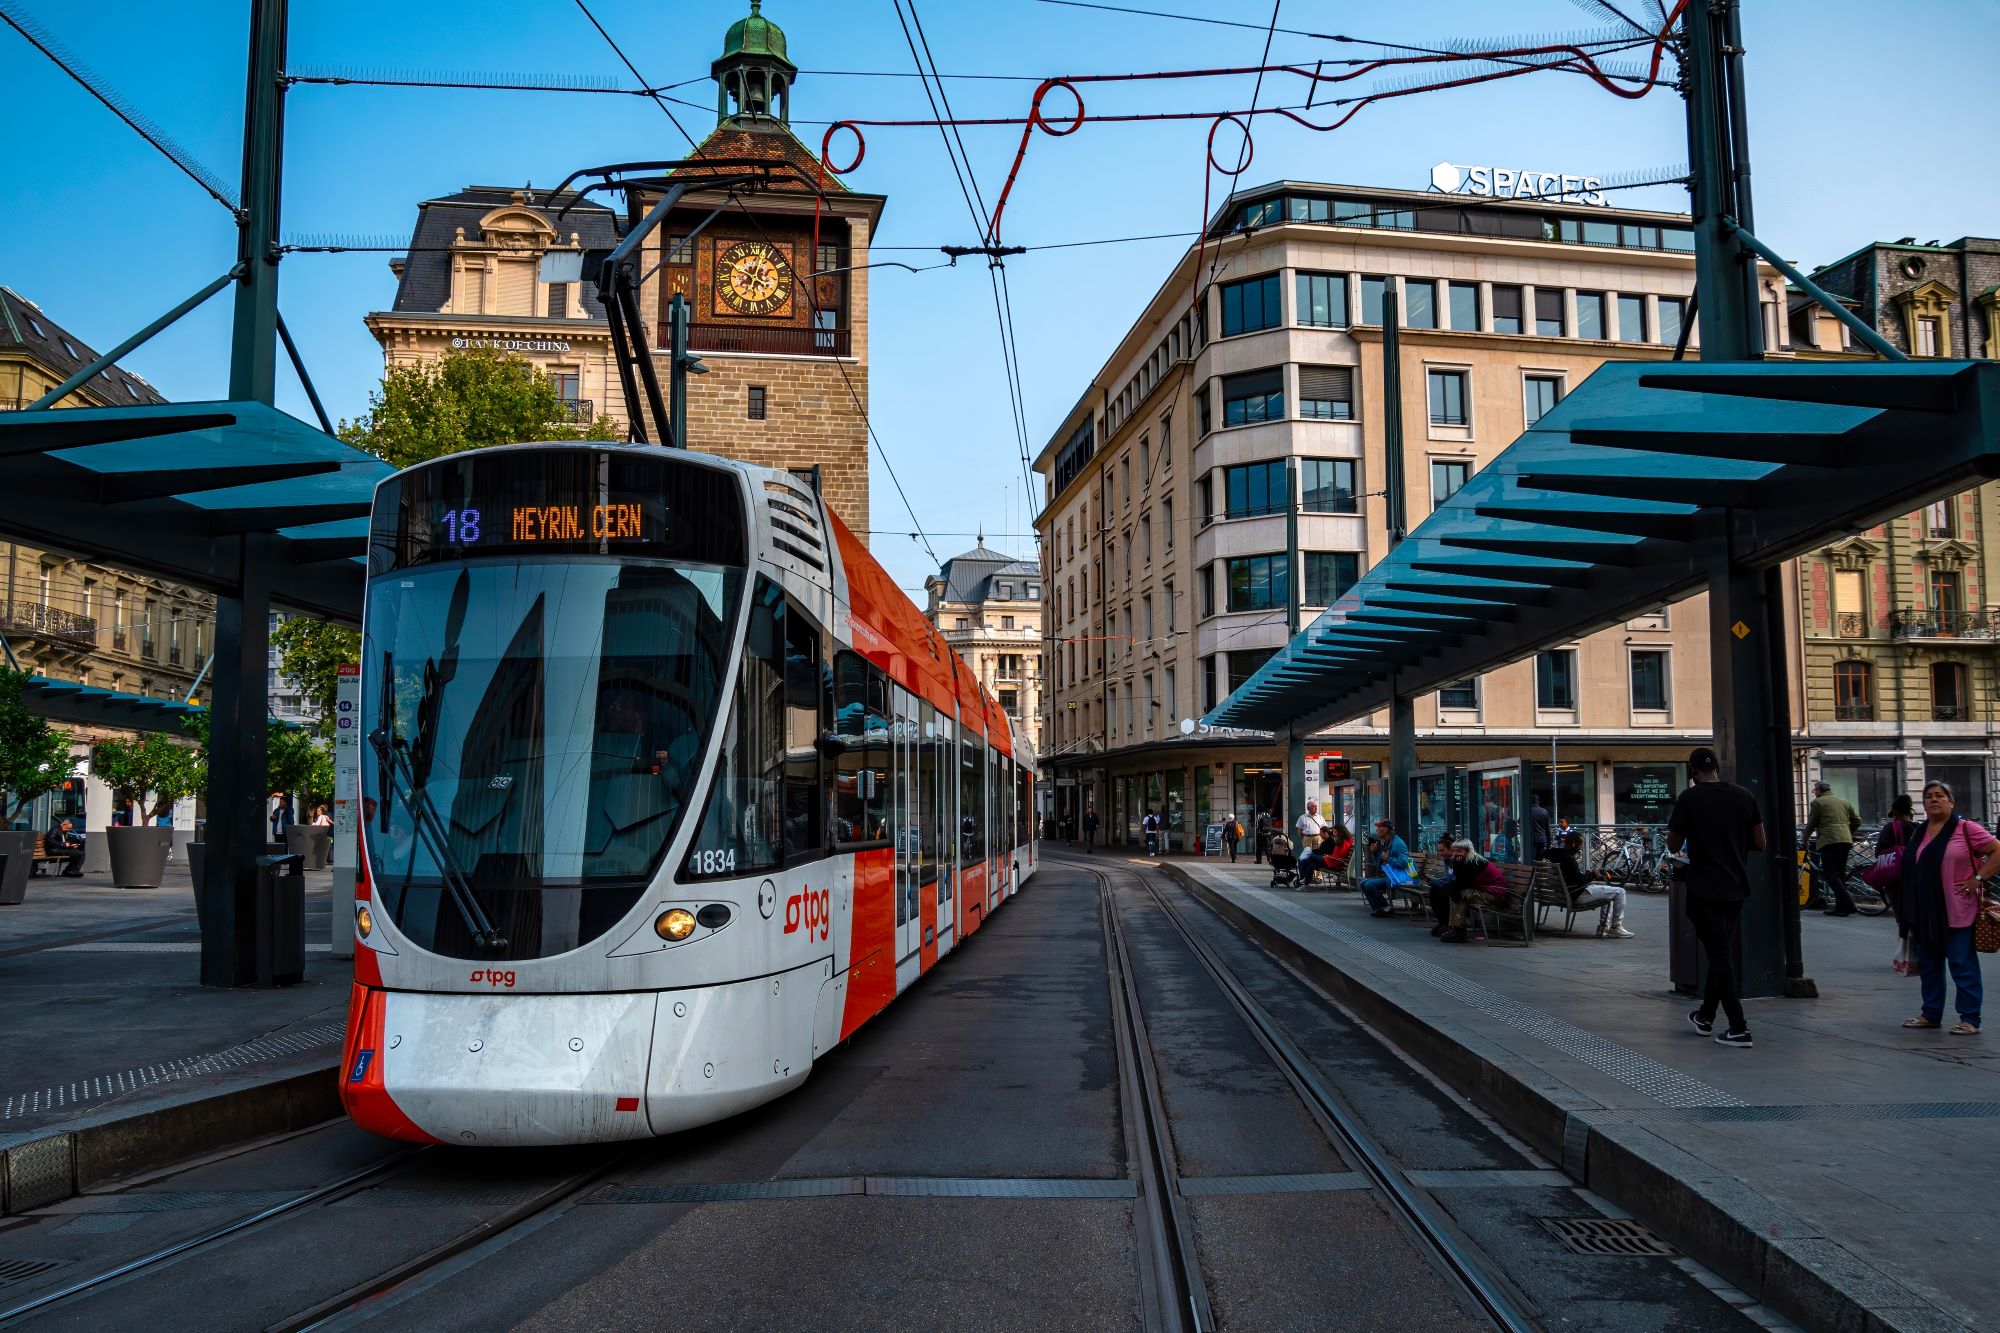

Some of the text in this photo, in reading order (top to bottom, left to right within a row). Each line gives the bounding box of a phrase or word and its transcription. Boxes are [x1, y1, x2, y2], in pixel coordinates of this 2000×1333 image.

[505, 340, 524, 351] OF
[527, 341, 571, 352] CHINA
[441, 503, 642, 542] 18 MEYRIN, CERN
[693, 848, 736, 874] 1834
